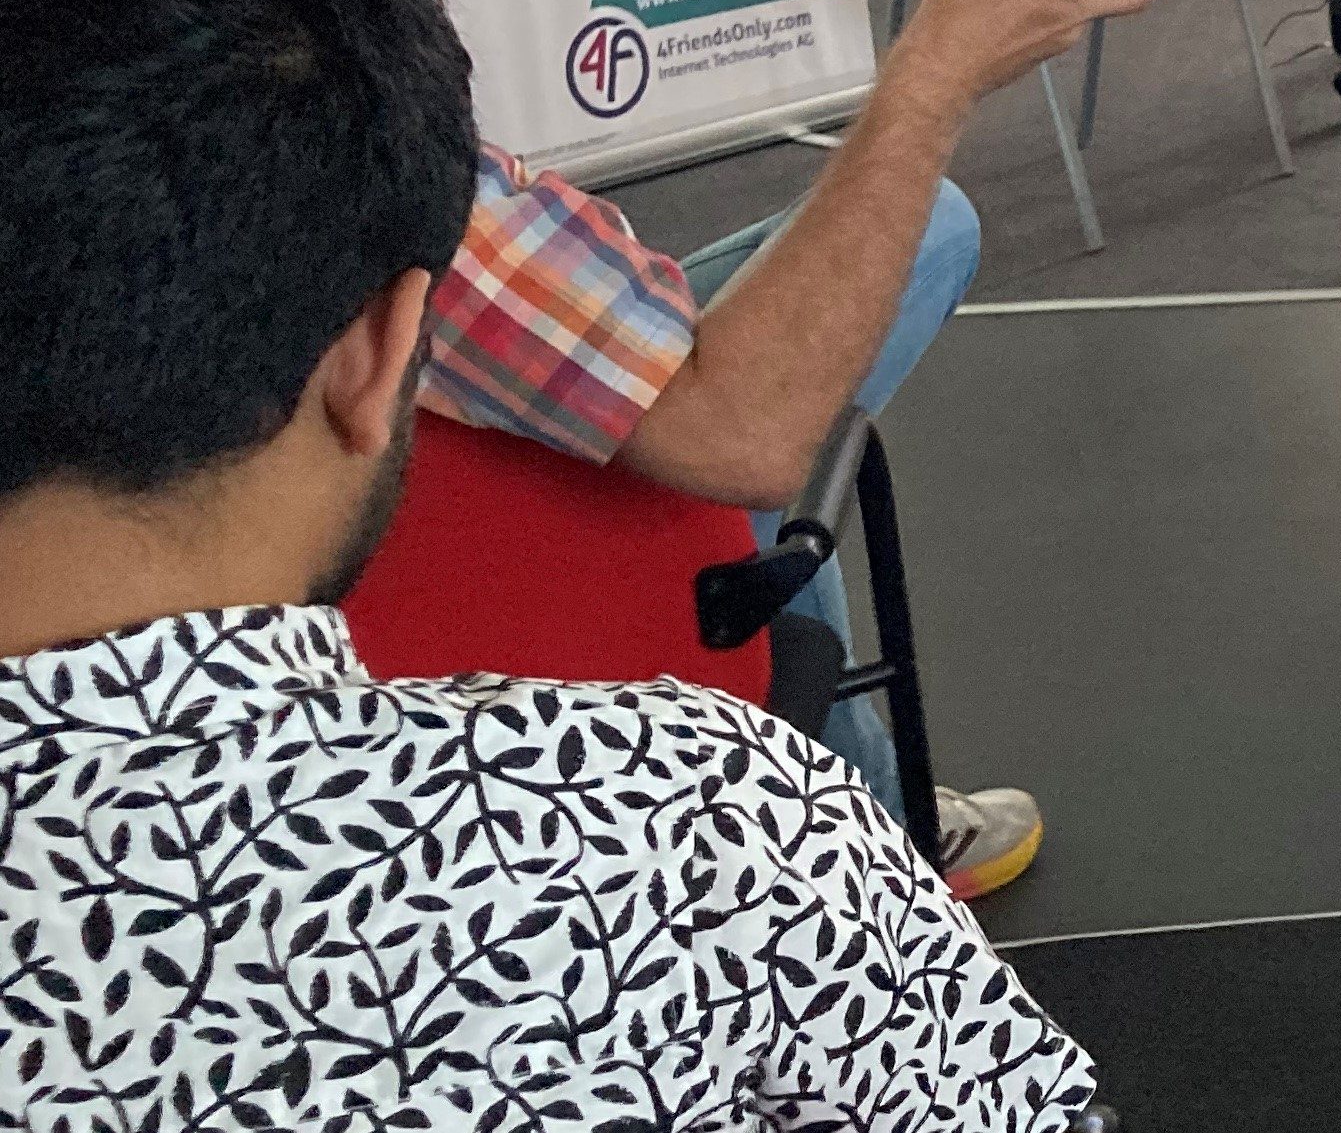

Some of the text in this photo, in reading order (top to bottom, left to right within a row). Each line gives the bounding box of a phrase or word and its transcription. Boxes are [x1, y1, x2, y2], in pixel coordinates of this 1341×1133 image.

[657, 11, 813, 58] 4FriendsOnly.com
[658, 32, 815, 80] Internet Technologies AG
